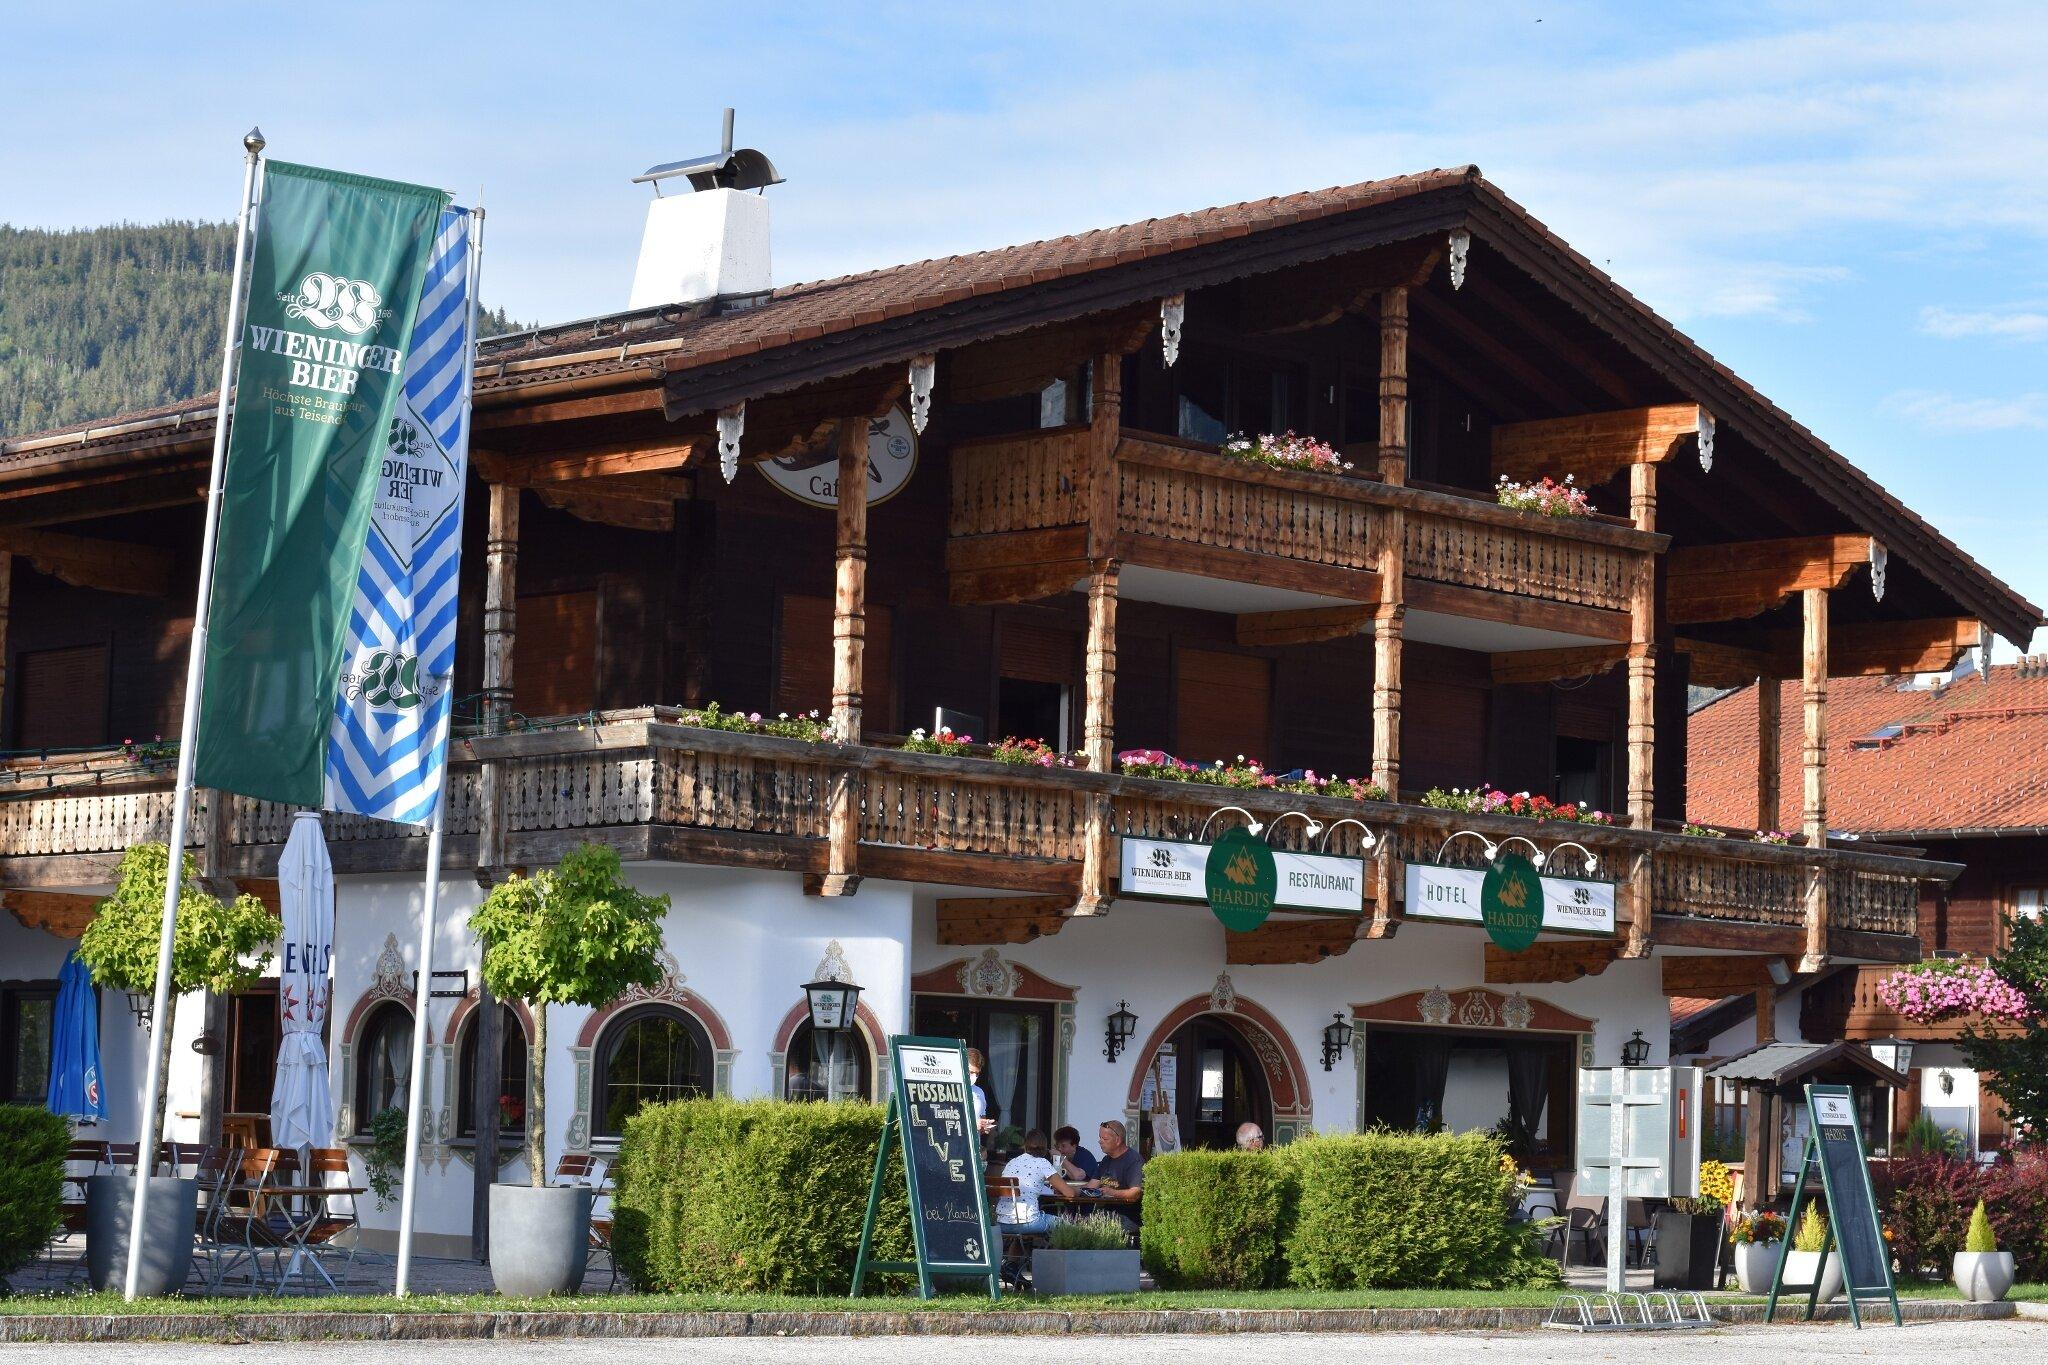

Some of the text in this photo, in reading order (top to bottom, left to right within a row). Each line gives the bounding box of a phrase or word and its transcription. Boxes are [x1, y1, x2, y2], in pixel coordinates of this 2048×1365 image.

[276, 291, 295, 303] Seit
[250, 325, 402, 375] WIENINGER
[289, 359, 360, 396] BIER
[263, 387, 312, 406] Höchste
[275, 405, 295, 417] aus
[809, 476, 839, 498] Caf
[1131, 867, 1192, 881] WIENINGER BIER
[1289, 871, 1355, 892] RESTAURANT
[1212, 888, 1270, 908] HARDI'S
[1427, 884, 1467, 904] HOTEL
[1592, 907, 1607, 917] BIER
[907, 1082, 963, 1102] FUSSBALL
[929, 1104, 960, 1120] Tennis
[945, 1120, 962, 1137] F1
[924, 1203, 944, 1220] bei
